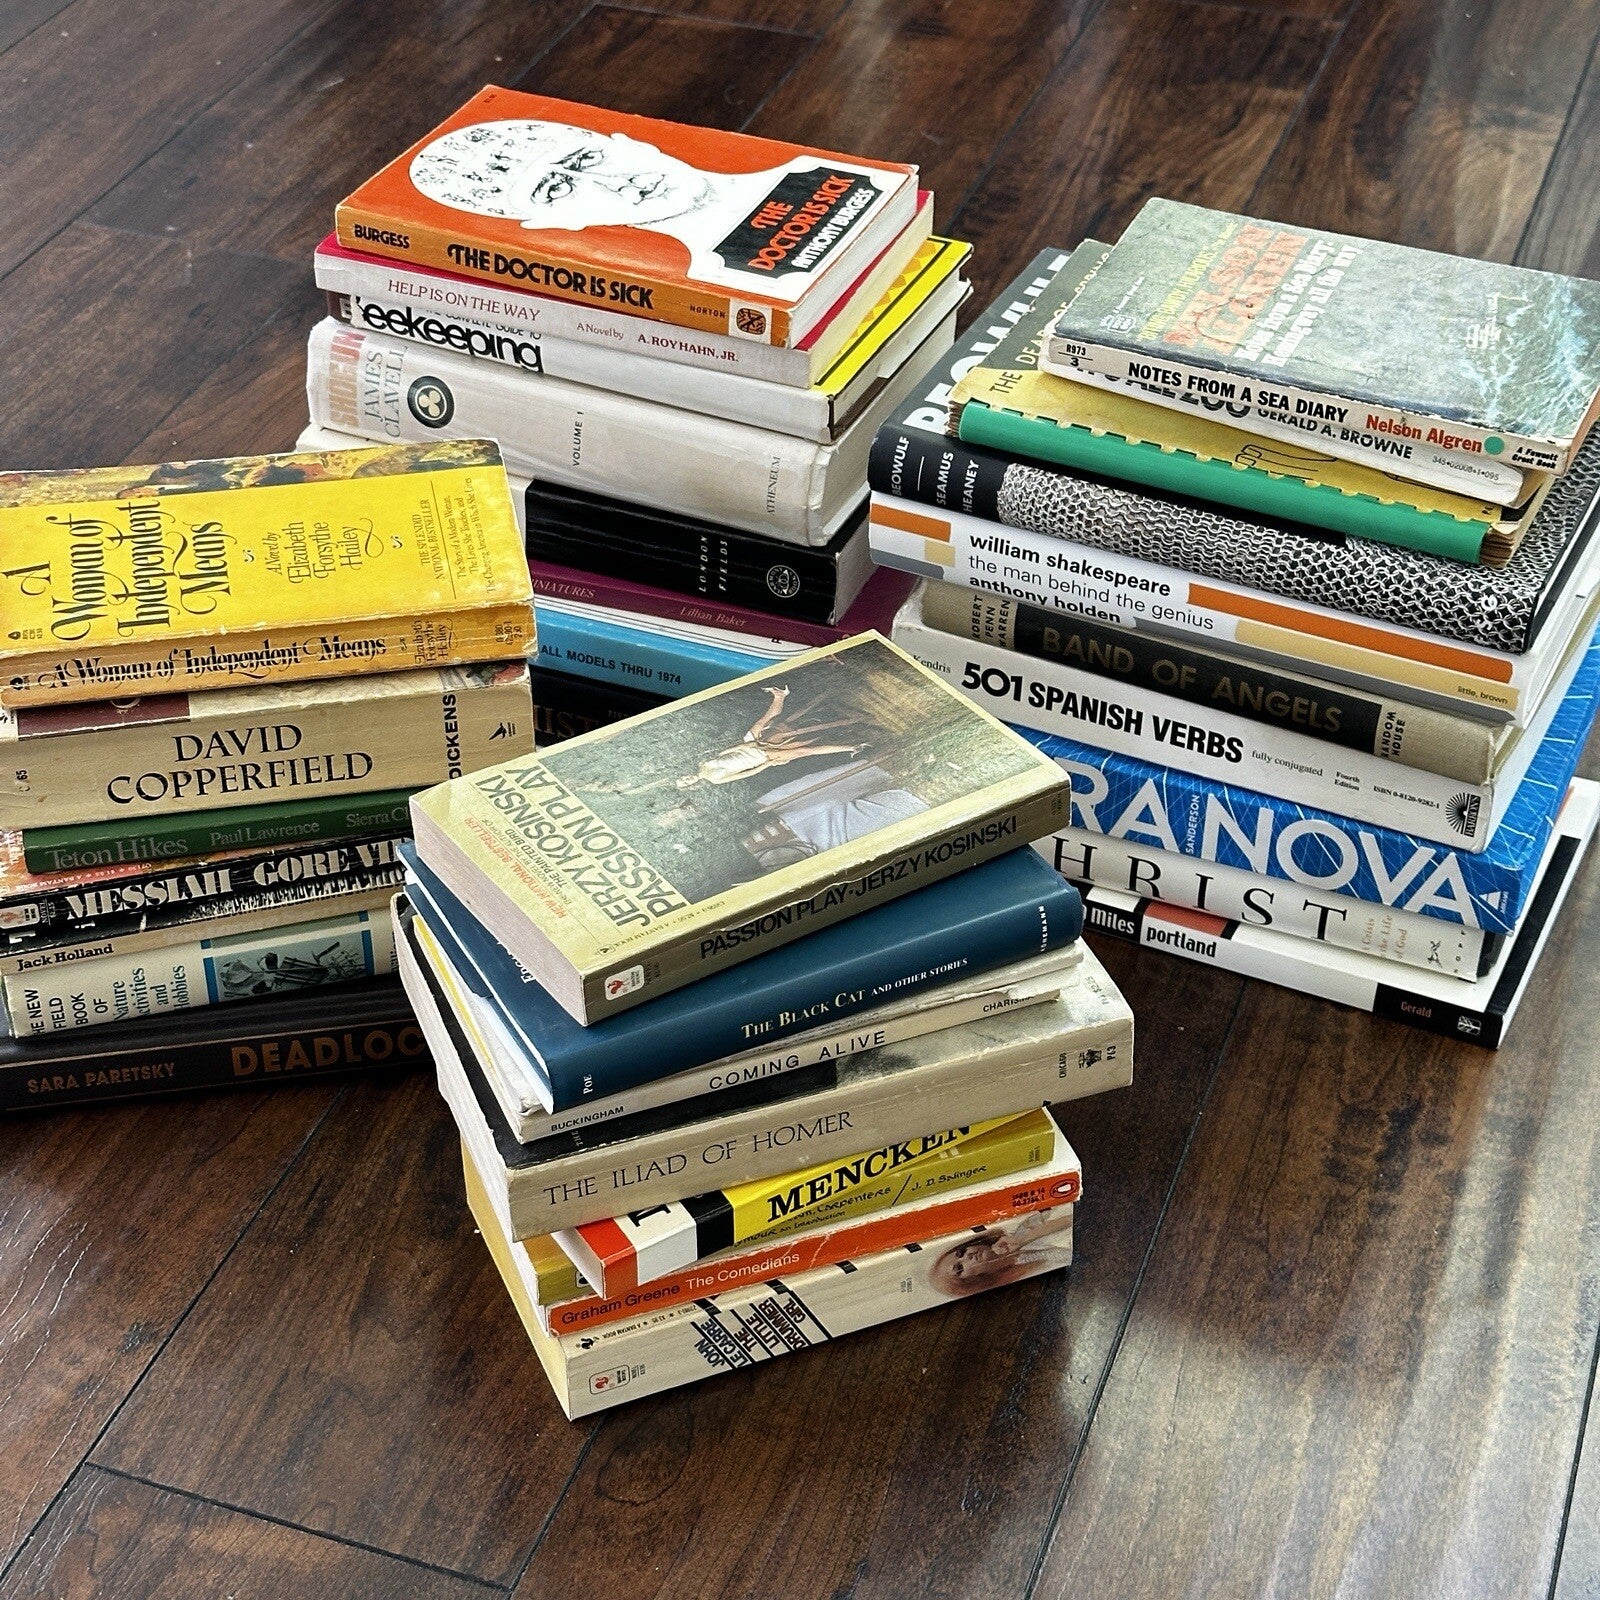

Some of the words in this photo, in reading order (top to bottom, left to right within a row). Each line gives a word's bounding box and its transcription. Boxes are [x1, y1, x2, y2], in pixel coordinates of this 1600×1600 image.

[813, 175, 855, 204] SICK
[751, 201, 794, 229] THE
[791, 225, 844, 269] ANTHONY
[834, 188, 876, 227] BURGESS
[803, 201, 830, 220] IS
[354, 224, 410, 249] BURGESS
[748, 210, 821, 271] DOCTOR
[447, 244, 492, 272] THE
[494, 252, 587, 294] DOCTOR
[590, 275, 607, 297] IS
[609, 281, 655, 311] SICK
[388, 279, 429, 301] HELP
[430, 289, 443, 302] IS
[445, 292, 468, 308] ON
[470, 296, 500, 314] THE
[502, 302, 541, 321] WAY
[690, 305, 726, 320] NORTON
[577, 322, 585, 332] A
[585, 323, 613, 338] Novel
[613, 329, 624, 341] by
[638, 334, 650, 344] A.
[651, 336, 679, 350] ROY
[678, 342, 719, 360] HAHN,
[720, 350, 740, 362] JR.
[1066, 344, 1087, 356] R973
[1070, 356, 1080, 367] 3
[364, 350, 384, 421] JAMES
[382, 345, 408, 438] CLAVELL
[989, 371, 1023, 394] THE
[1129, 361, 1182, 387] NOTES
[1187, 374, 1235, 399] FROM
[1240, 387, 1252, 403] A
[1257, 391, 1290, 412] SEA
[1295, 396, 1349, 423] DIARY
[572, 421, 584, 467] VOLUME
[1258, 408, 1319, 432] GERALD
[1321, 424, 1337, 438] A.
[1340, 427, 1413, 459] BROWNE
[1366, 413, 1422, 440] Nelson
[1426, 427, 1483, 453] Algren
[766, 455, 781, 516] ATHENEUM
[891, 436, 910, 496] BEOWULF
[936, 451, 954, 505] SEAMUS
[963, 459, 980, 513] HEANEY
[107, 500, 183, 638] Independent
[178, 521, 237, 615] Means
[265, 541, 281, 564] Novel
[281, 521, 311, 584] Elizabeth
[308, 521, 337, 579] Forsythe
[698, 535, 709, 593] LONDON
[718, 539, 729, 592] FIELDS
[969, 534, 1041, 563] william
[1046, 553, 1172, 597] shakespeare
[50, 538, 108, 641] Woman
[969, 554, 997, 574] the
[1003, 566, 1042, 586] man
[1048, 574, 1110, 604] behind
[1116, 592, 1146, 612] the
[1152, 603, 1215, 631] genius
[969, 576, 1048, 607] anthony
[1054, 596, 1121, 624] holden
[680, 606, 714, 621] Lillian
[717, 610, 748, 627] Baker
[971, 594, 984, 640] ROBERT
[985, 606, 997, 638] PENN
[64, 656, 152, 688] Woman
[180, 636, 304, 679] Independent
[305, 635, 387, 662] Means
[541, 644, 562, 659] ALL
[566, 650, 616, 670] MODELS
[620, 662, 653, 678] THRU
[657, 671, 682, 685] 1974
[1042, 626, 1135, 673] BAND
[1152, 659, 1197, 690] OF
[1210, 676, 1342, 732] ANGELS
[961, 661, 1024, 702] 501
[1028, 681, 1143, 736] SPANISH
[1153, 715, 1244, 764] VERBS
[1457, 685, 1478, 699] little,
[1480, 691, 1508, 705] brown
[173, 724, 303, 762] DAVID
[442, 694, 462, 780] DICKENS
[1381, 711, 1396, 758] RANDOM
[1392, 719, 1406, 757] HOUSE
[107, 752, 373, 804] COPPERFIELD
[1251, 750, 1272, 763] fully
[1274, 755, 1324, 777] conjugated
[1336, 770, 1361, 783] Fourth
[1334, 778, 1361, 791] Edition
[1373, 784, 1392, 796] ISBN
[210, 830, 244, 847] Paul
[246, 821, 320, 842] Lawrence
[346, 812, 389, 829] Sierra
[1185, 794, 1200, 855] SANDERSON
[45, 844, 113, 870] Teton
[114, 838, 189, 861] Hikes
[475, 774, 583, 866] KOSINSKI
[562, 867, 651, 928] JERZY
[503, 765, 583, 826] PLAY
[565, 818, 688, 918] PASSION
[1200, 792, 1481, 930] NOVA
[253, 848, 350, 887] GORE
[521, 843, 555, 876] PAINTED
[548, 870, 568, 889] THE
[65, 868, 234, 920] MESSIAH
[701, 906, 793, 960] PASSION
[797, 881, 848, 922] PLAY
[856, 854, 922, 897] JERZY
[925, 815, 1018, 868] KOSINSKI
[1090, 907, 1135, 935] miles
[1146, 925, 1217, 958] portland
[17, 954, 53, 972] Jack
[54, 943, 115, 963] Holland
[871, 983, 892, 996] AND
[894, 971, 928, 989] OTHER
[929, 957, 968, 978] STORIES
[24, 988, 42, 1019] NEW
[49, 997, 67, 1028] FIELD
[70, 992, 89, 1026] BOOK
[93, 998, 109, 1013] OF
[150, 983, 169, 1006] and
[741, 1019, 774, 1039] THE
[779, 1000, 830, 1026] BLACK
[834, 988, 866, 1008] CAT
[1400, 1001, 1432, 1019] Gerald
[27, 1074, 80, 1094] SARA
[84, 1062, 176, 1088] PARETSKY
[709, 1053, 800, 1091] COMING
[818, 1030, 886, 1061] ALIVE
[1058, 1051, 1068, 1078] CHICAGO
[583, 1074, 593, 1095] POE
[550, 1105, 625, 1132] BUCKINGHAM
[543, 1176, 598, 1206] THE
[612, 1154, 688, 1190] ILIAD
[702, 1140, 738, 1165] OF
[753, 1111, 854, 1153] HOMER
[561, 1300, 622, 1326] Graham
[624, 1283, 681, 1308] Greene
[686, 1275, 715, 1290] The
[717, 1252, 801, 1283] Comedians
[745, 1312, 782, 1350] LITTLE
[757, 1297, 808, 1351] DRUMMER
[782, 1297, 807, 1324] GIRL
[693, 1337, 726, 1368] JOHN
[733, 1324, 760, 1352] THE
[732, 1350, 750, 1370] LE
